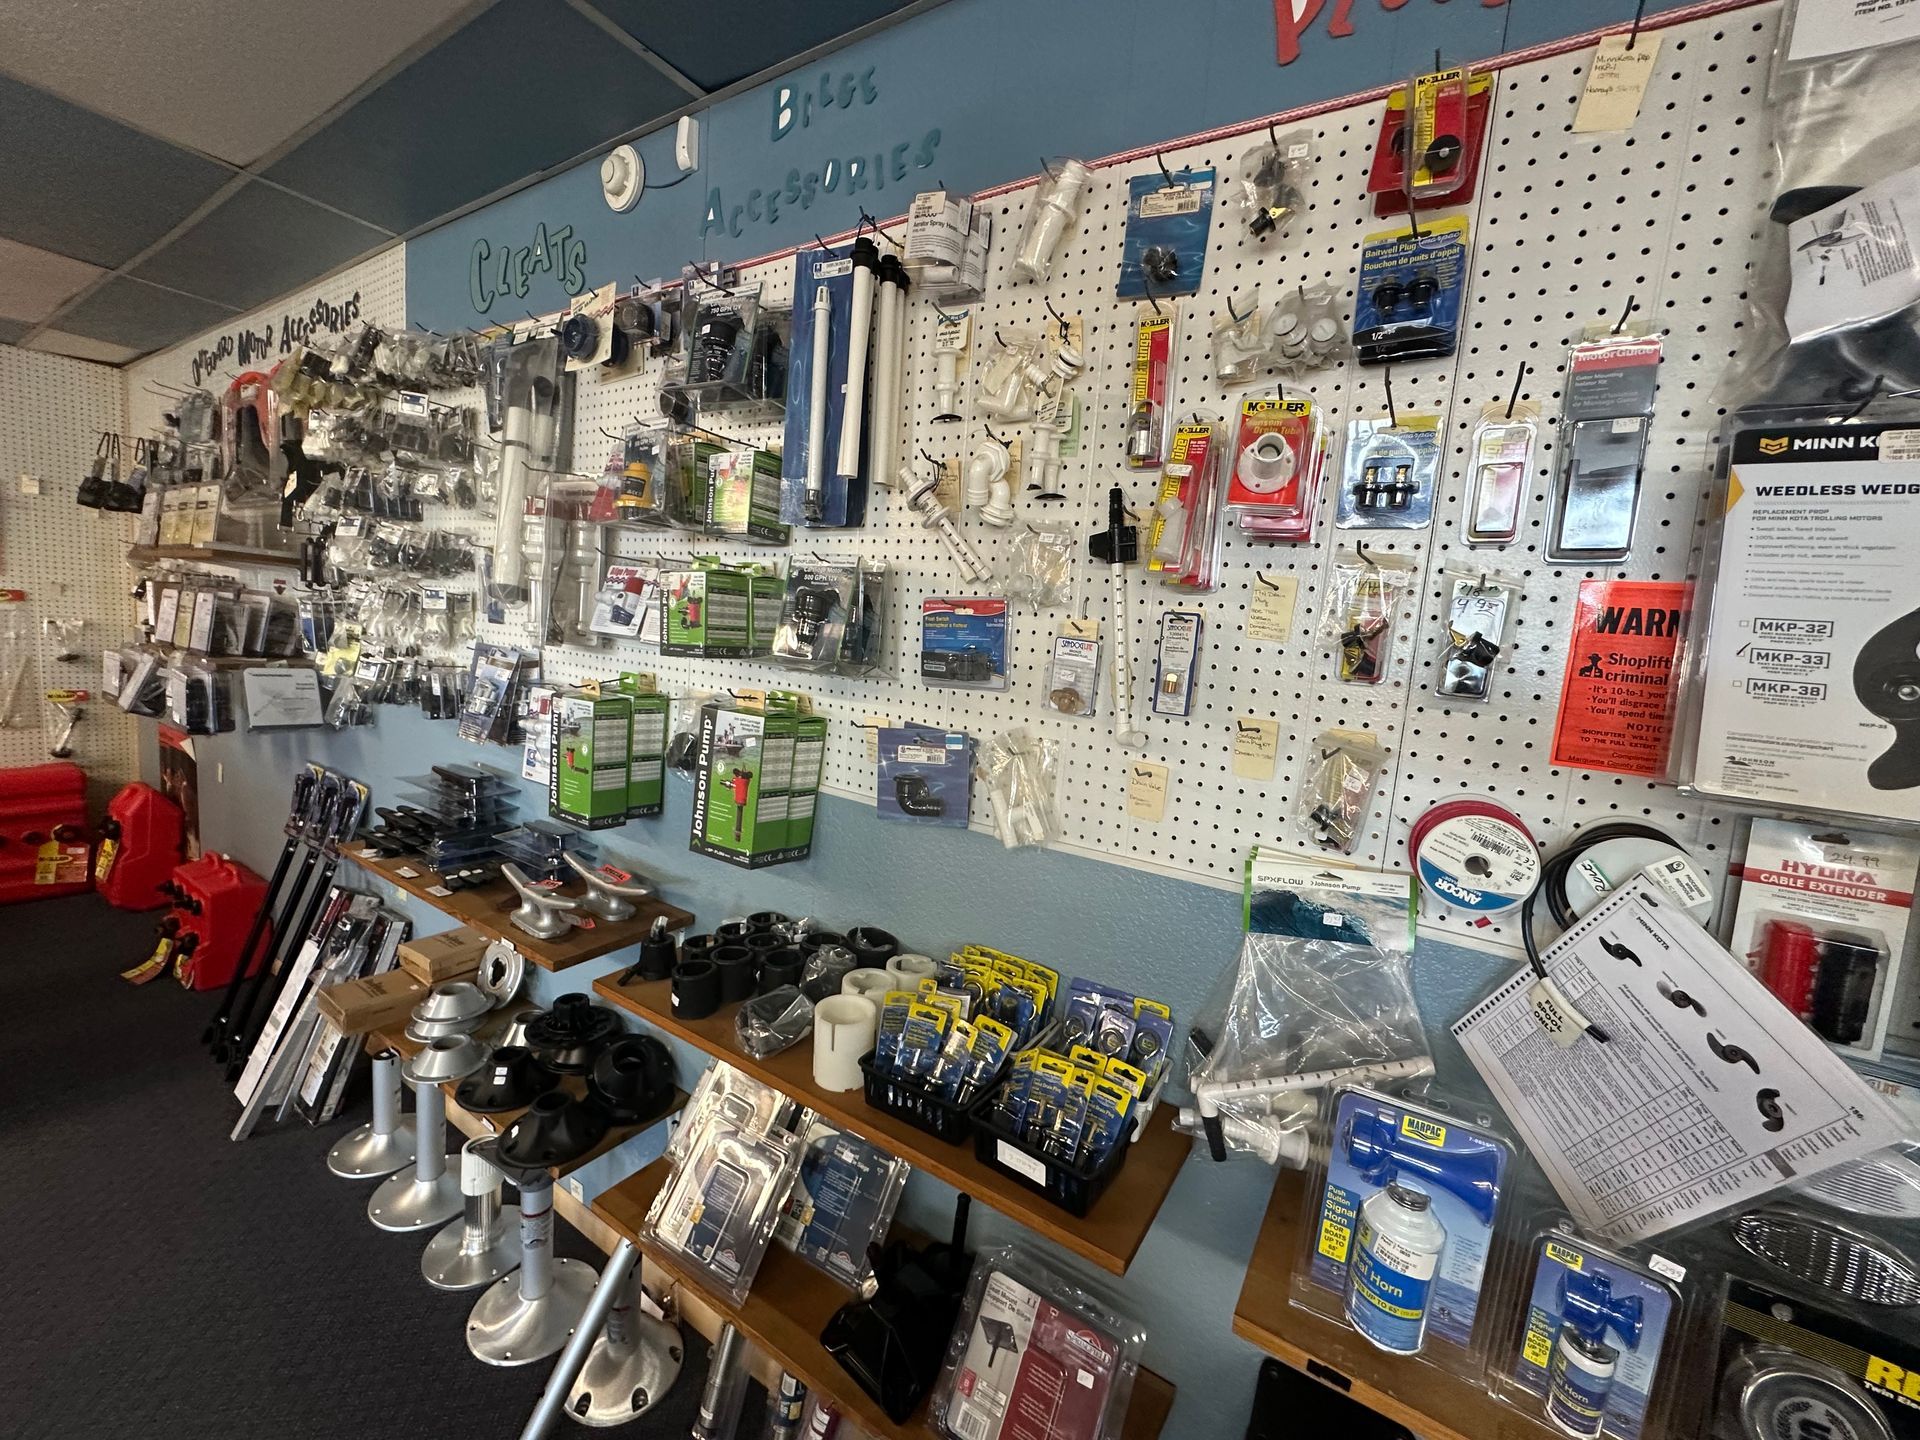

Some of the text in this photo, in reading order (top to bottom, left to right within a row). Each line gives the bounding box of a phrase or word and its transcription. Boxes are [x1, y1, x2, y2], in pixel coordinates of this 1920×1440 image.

[1854, 7, 1876, 16] ITEM
[1417, 71, 1460, 86] MOELLER
[771, 65, 878, 142] BILGE
[700, 127, 942, 239] ACCESSORIES
[929, 219, 945, 229] Spray
[1365, 242, 1417, 258] Baitwell Plug
[469, 222, 587, 314] CLEATS
[1364, 258, 1397, 271] Bouchon
[1398, 255, 1409, 265] de
[1409, 252, 1429, 265] puits
[237, 324, 274, 366] MOTOR
[279, 290, 362, 355] ACCESSORIES
[1140, 317, 1170, 329] MOELLER
[1577, 347, 1654, 362] MotorGuide
[1247, 401, 1307, 412] MOELLER
[1177, 425, 1210, 434] MOELLER
[1253, 426, 1277, 435] Drain
[1793, 436, 1854, 450] MINN
[1755, 485, 1856, 497] WEEDLESS
[706, 490, 714, 524] Johnson
[1760, 621, 1828, 634] MKP-32
[1608, 652, 1672, 670] Shoplift
[1756, 651, 1824, 665] MKP-33
[1605, 670, 1669, 686] criminal
[1611, 687, 1644, 697] 10-to-1
[1752, 681, 1821, 696] MKP-38
[1619, 698, 1660, 709] disgrace
[1617, 708, 1645, 719] spend
[1649, 711, 1665, 720] tim
[1582, 728, 1626, 738] SHOPLIFTERS
[1609, 739, 1626, 747] FULL
[1568, 755, 1634, 769] Marquette County
[1737, 756, 1776, 765] JOHNSON
[550, 748, 559, 806] Johnson
[693, 718, 714, 838] Johnson Pump
[1781, 859, 1878, 886] HYDRA
[1257, 875, 1304, 886] SPXFLOW
[1313, 880, 1341, 890] Johnson
[1341, 883, 1362, 892] Pump
[1760, 873, 1888, 902] CABLE EXTENDER
[1434, 878, 1483, 906] ANCOR
[1634, 915, 1671, 951] MINN KOTA
[1536, 1001, 1562, 1033] SPOOL
[1544, 999, 1563, 1024] FULL
[1534, 1010, 1556, 1033] ONLY
[1407, 1117, 1441, 1138] MARPAC
[1327, 1191, 1351, 1206] Button
[1328, 1185, 1346, 1197] Push
[1324, 1209, 1348, 1225] Horn
[1325, 1200, 1357, 1219] Signal
[1324, 1228, 1347, 1241] BOATS
[1329, 1222, 1344, 1233] FOR
[1335, 1239, 1345, 1248] TO
[1551, 1244, 1580, 1264] MARPAC
[1370, 1271, 1403, 1298] Horn
[1001, 1289, 1018, 1306] Mount
[1366, 1288, 1376, 1300] UP
[1376, 1297, 1387, 1308] TO
[1529, 1324, 1549, 1337] Horn
[1530, 1317, 1556, 1334] Signal
[1528, 1337, 1549, 1351] BOATS
[1532, 1334, 1547, 1343] FOR
[1538, 1347, 1548, 1356] TO
[1564, 1384, 1589, 1404] Horn
